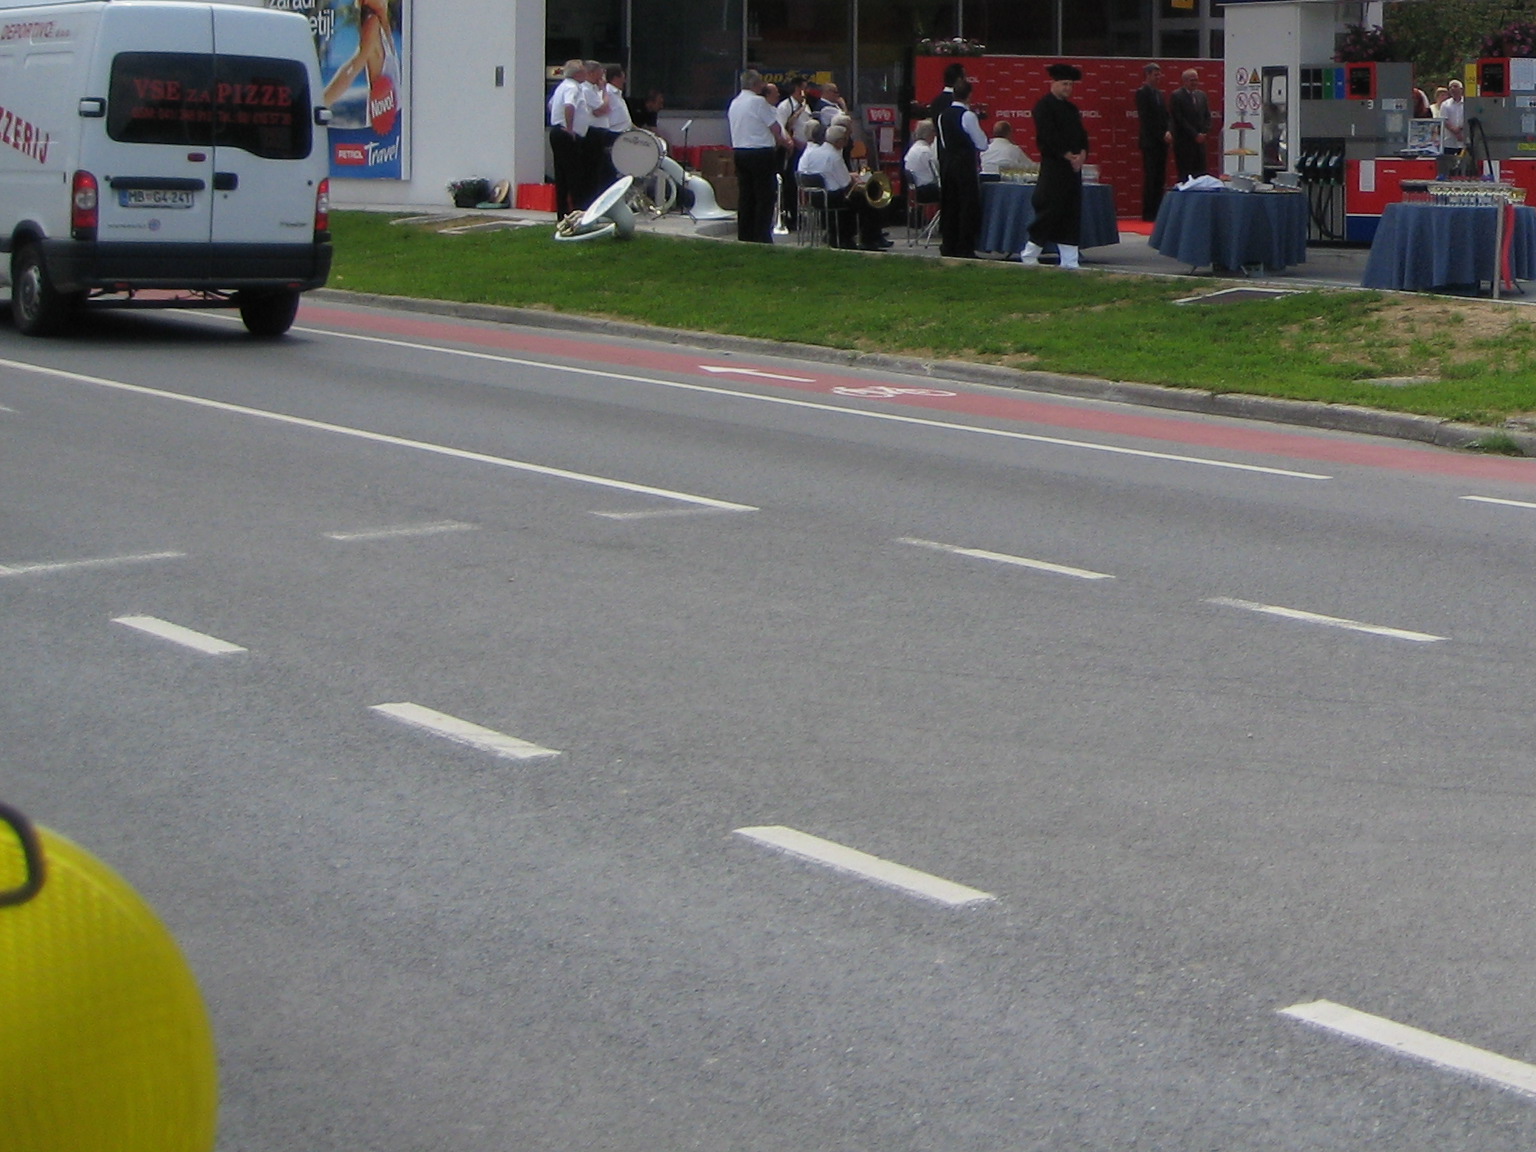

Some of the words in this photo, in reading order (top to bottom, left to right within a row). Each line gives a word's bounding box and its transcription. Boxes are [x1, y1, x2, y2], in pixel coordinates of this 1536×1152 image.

[133, 79, 181, 101] VSE
[183, 89, 210, 103] ZA
[216, 81, 292, 107] PIZZE
[371, 91, 394, 118] Novo!
[995, 110, 1033, 118] PETRO
[364, 135, 400, 167] Travel
